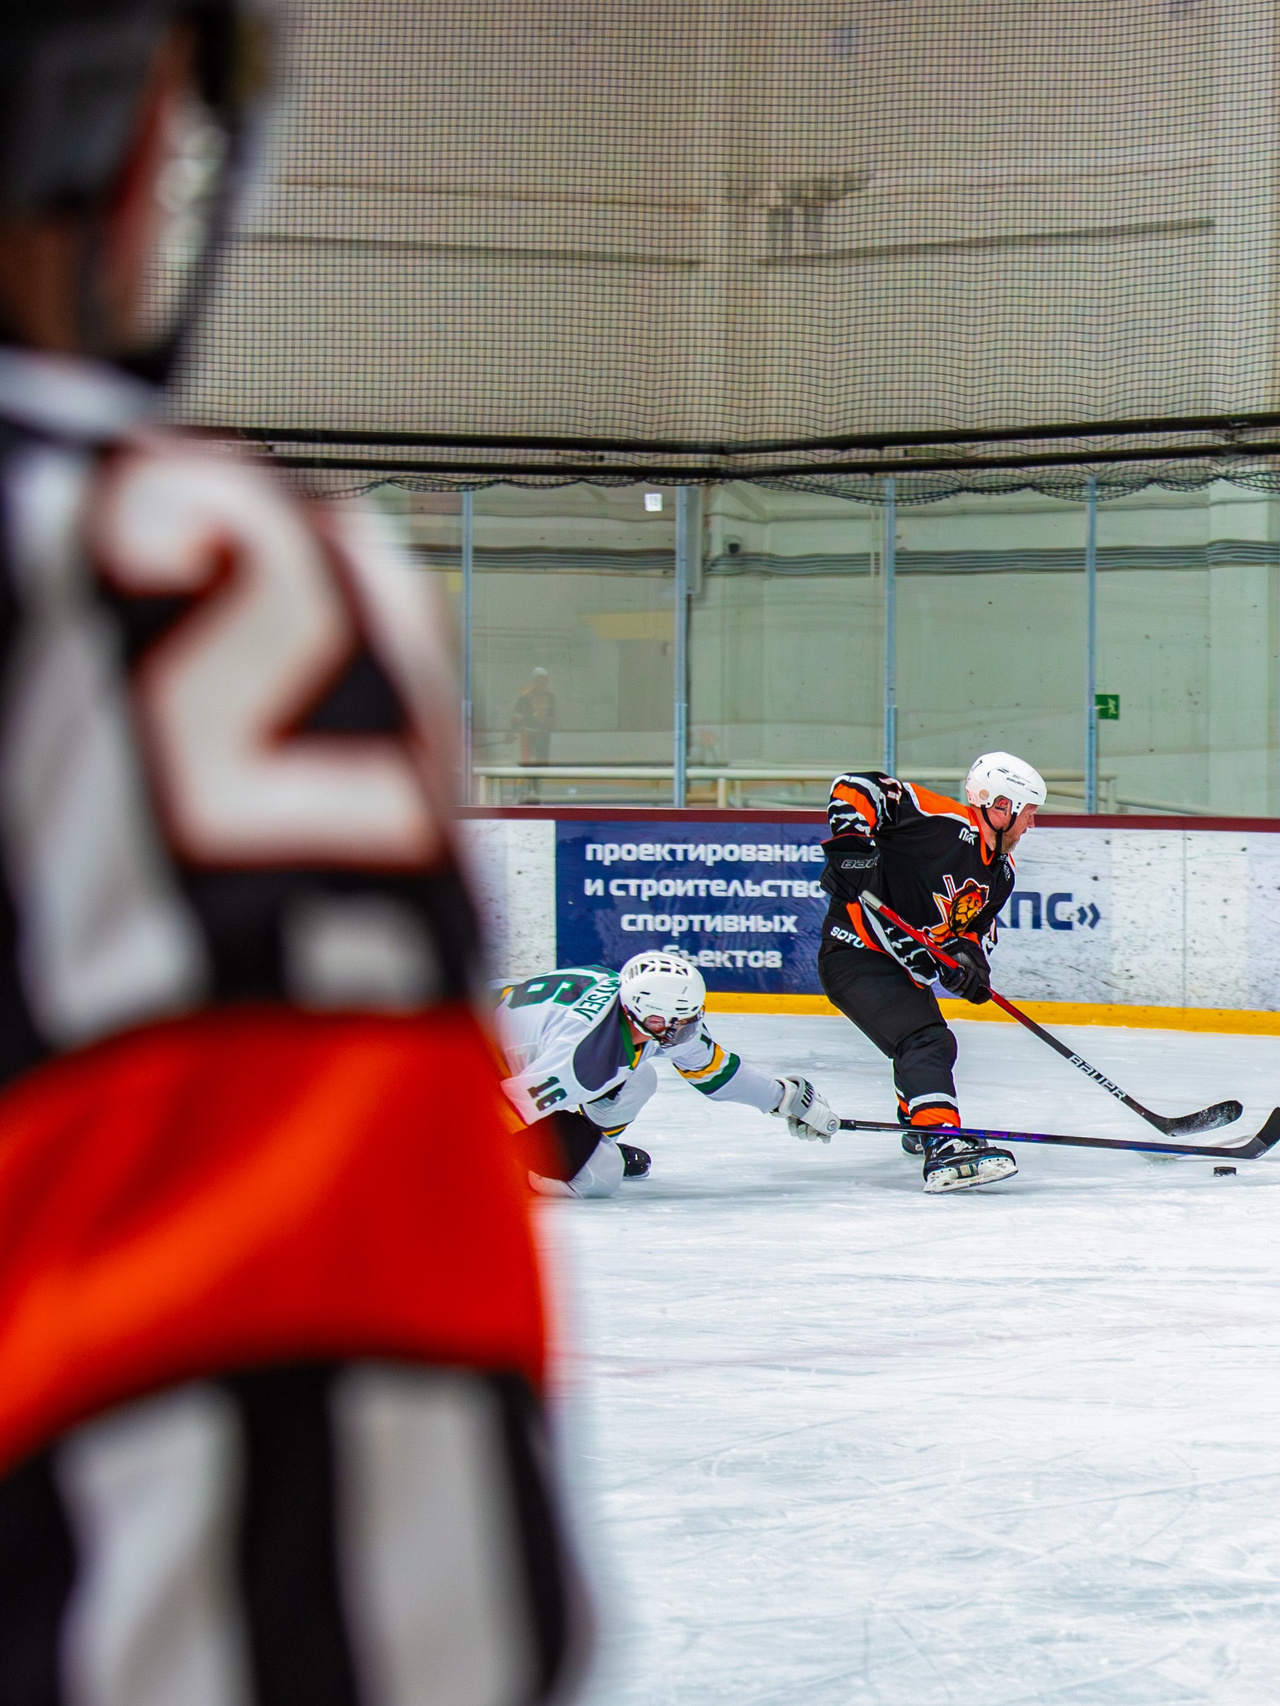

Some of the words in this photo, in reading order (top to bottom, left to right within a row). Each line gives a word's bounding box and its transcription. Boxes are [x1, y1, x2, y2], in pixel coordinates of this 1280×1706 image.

[585, 843, 825, 866] проектирование
[584, 878, 604, 896] и
[609, 878, 826, 901] строительство
[621, 914, 798, 937] спортивных
[830, 926, 868, 949] SOYU
[645, 945, 783, 968] бъектов
[1067, 1054, 1127, 1100] BAUER
[527, 1076, 568, 1111] 16
